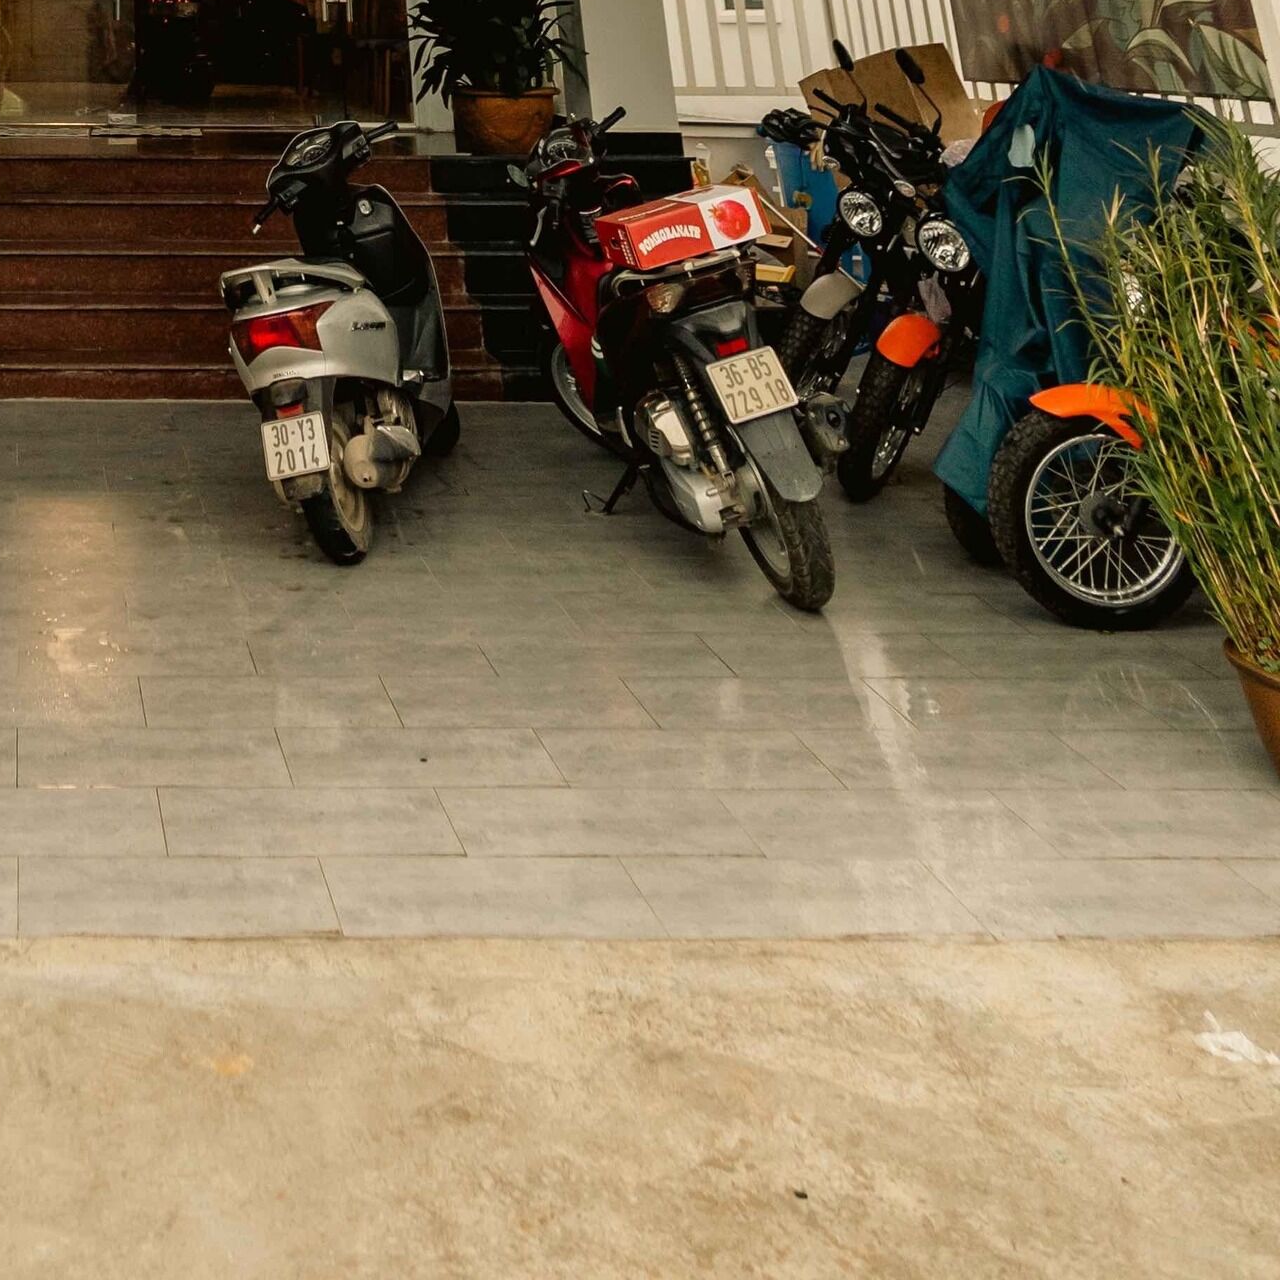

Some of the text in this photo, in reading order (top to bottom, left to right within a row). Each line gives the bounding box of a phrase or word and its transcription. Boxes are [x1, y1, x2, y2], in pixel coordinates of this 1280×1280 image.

[638, 224, 701, 256] POMEGRANATE
[720, 354, 772, 388] 36-B5
[725, 378, 790, 419] 729.18
[275, 443, 319, 474] 2014
